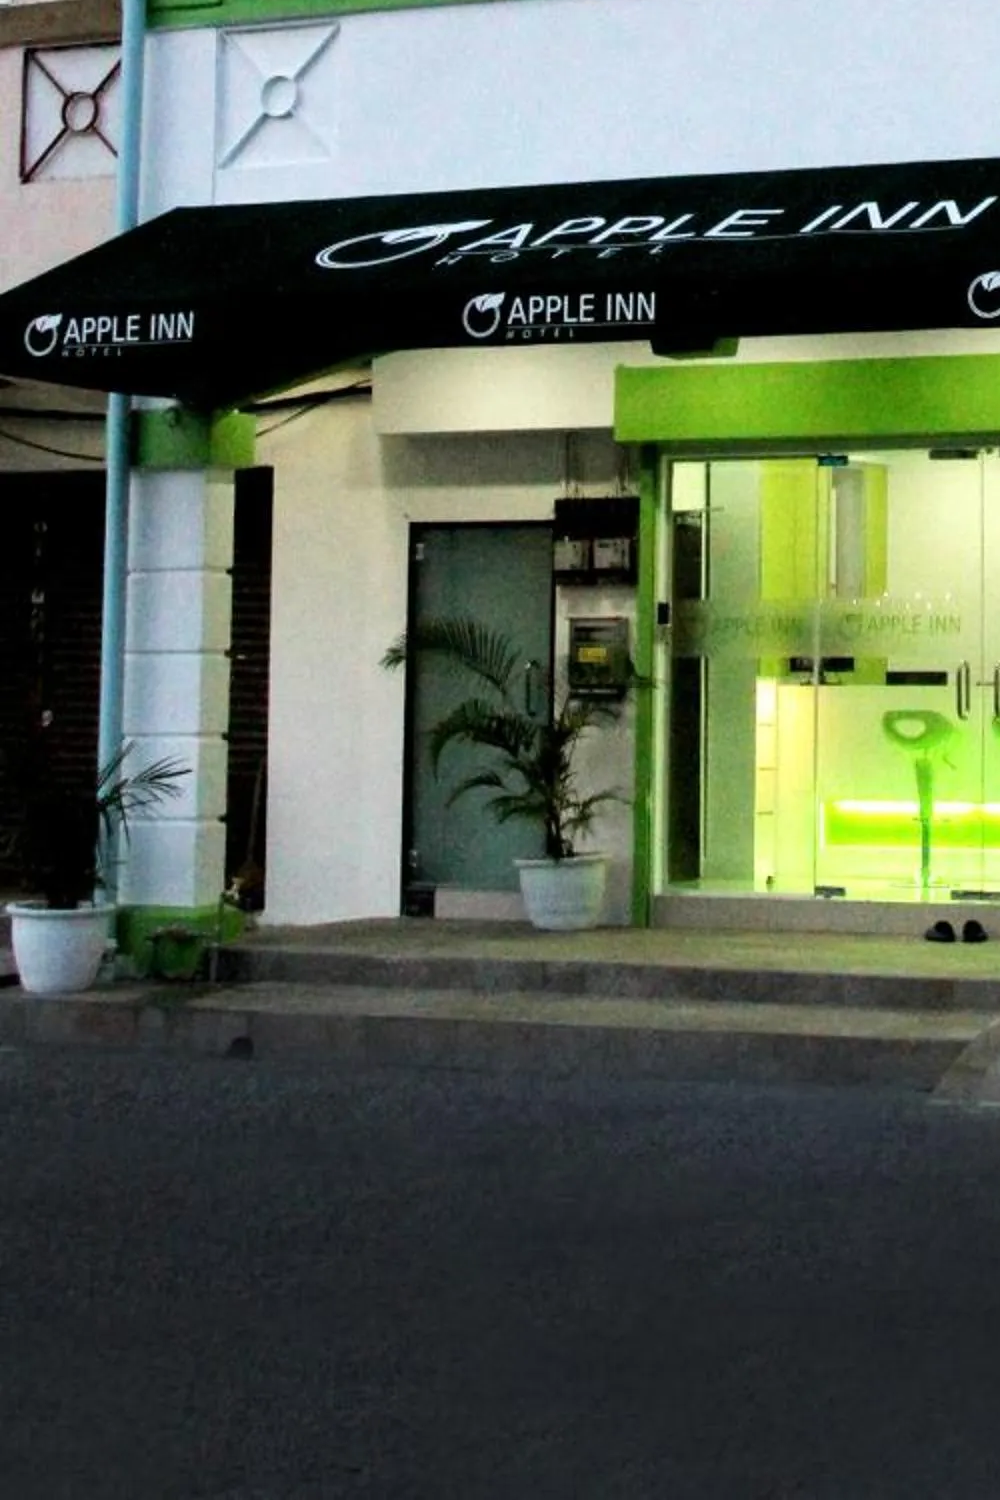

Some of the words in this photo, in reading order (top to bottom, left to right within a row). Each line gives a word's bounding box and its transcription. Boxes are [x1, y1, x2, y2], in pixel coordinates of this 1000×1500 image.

[457, 208, 784, 251] APPLE
[800, 195, 998, 233] INN
[507, 293, 595, 325] APPLE
[606, 291, 656, 321] INN
[63, 315, 141, 344] APPLE
[150, 310, 195, 341] INN
[867, 613, 922, 635] APPLE
[928, 612, 961, 633] INN
